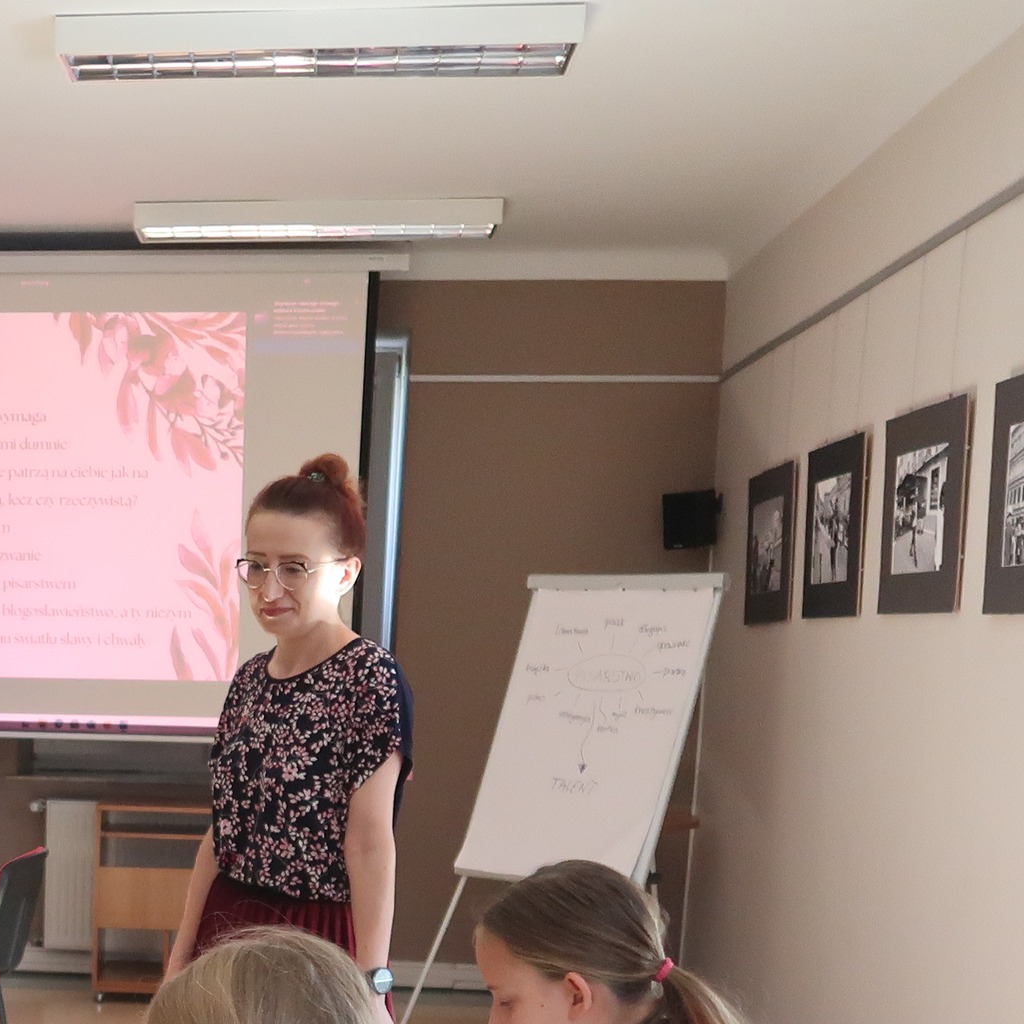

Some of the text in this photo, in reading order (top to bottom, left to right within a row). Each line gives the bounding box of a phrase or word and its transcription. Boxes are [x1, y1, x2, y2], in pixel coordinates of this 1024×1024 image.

[19, 437, 68, 451] dumnie
[52, 467, 68, 479] na
[70, 465, 108, 479] ciebie
[108, 465, 129, 482] jak
[132, 468, 149, 479] na
[8, 492, 33, 506] lecz
[35, 496, 54, 509] czy
[2, 577, 77, 593] pisarstwem
[120, 607, 129, 618] a
[145, 606, 192, 622] niczym
